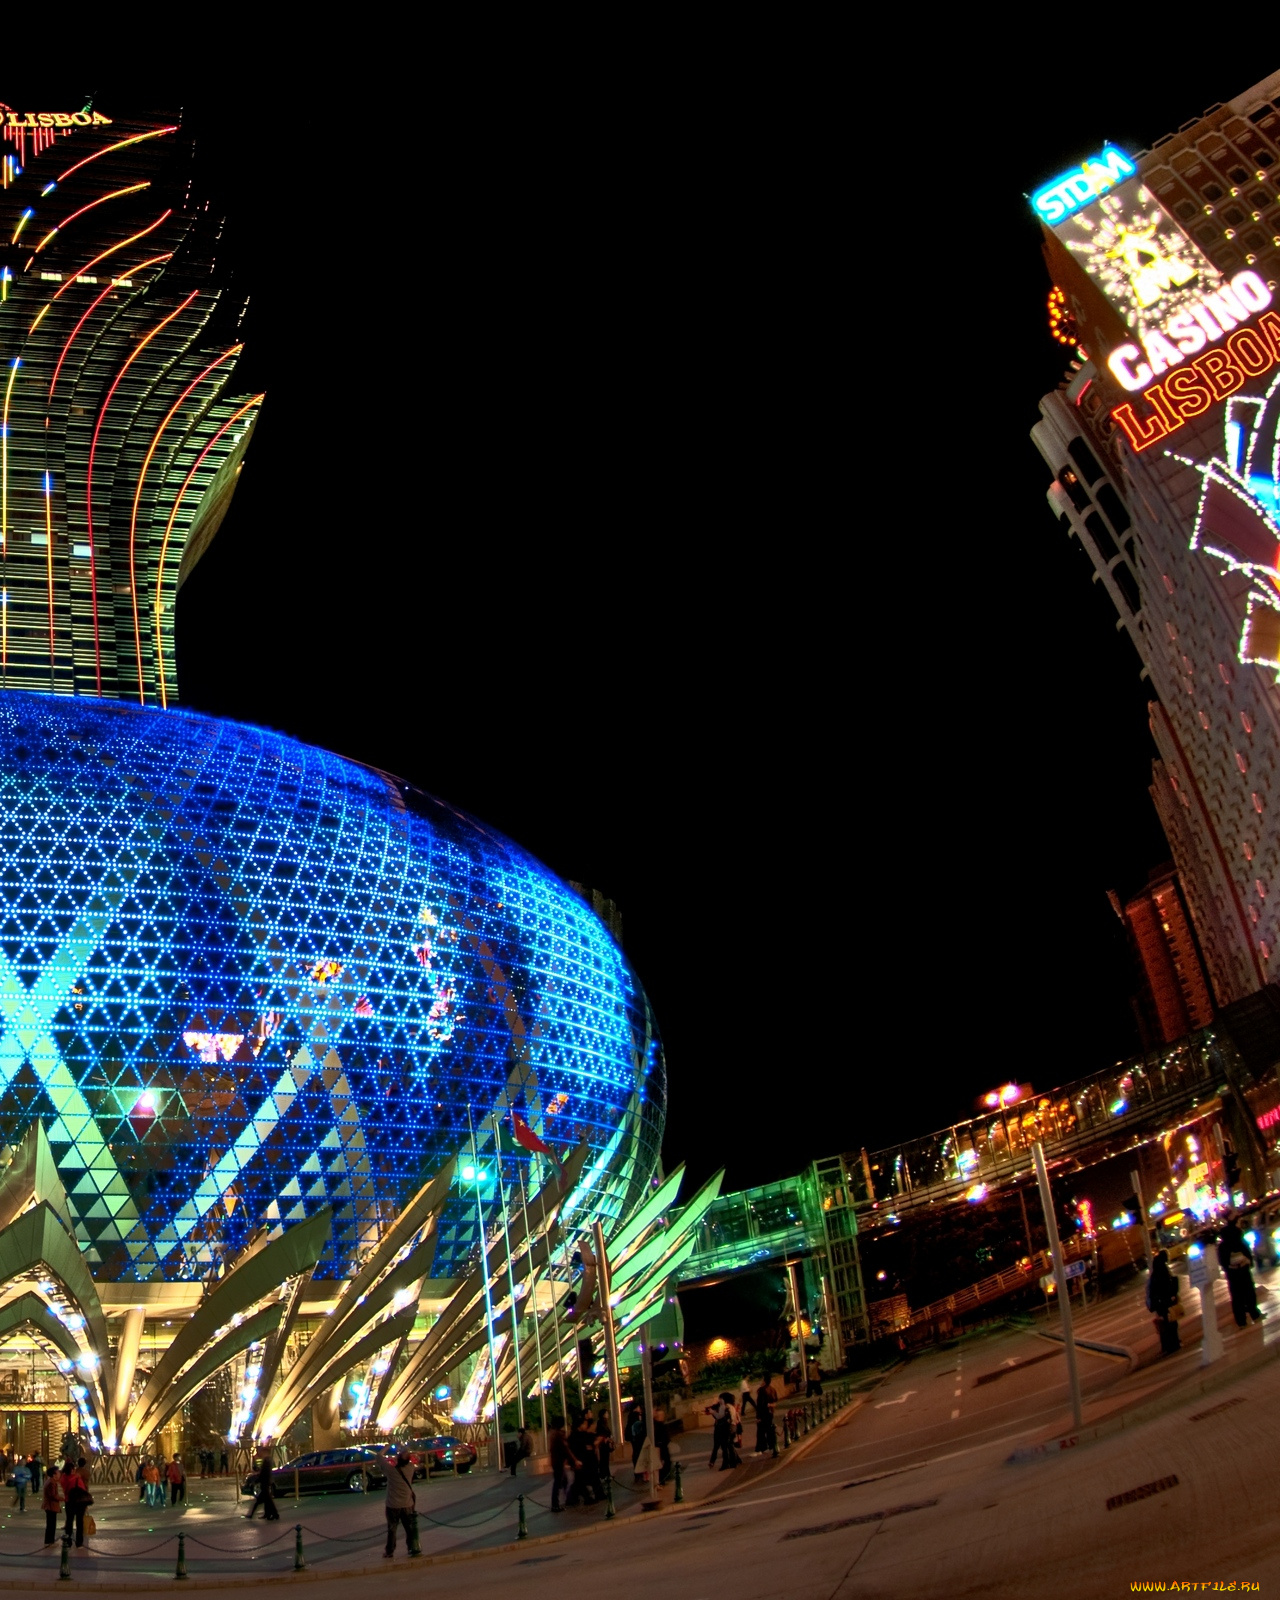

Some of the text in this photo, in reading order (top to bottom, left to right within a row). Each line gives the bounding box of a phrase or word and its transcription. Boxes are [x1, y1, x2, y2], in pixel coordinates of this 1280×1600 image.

[6, 110, 113, 127] LISBOA
[1033, 147, 1137, 224] STDM
[1107, 270, 1272, 391] CASINO
